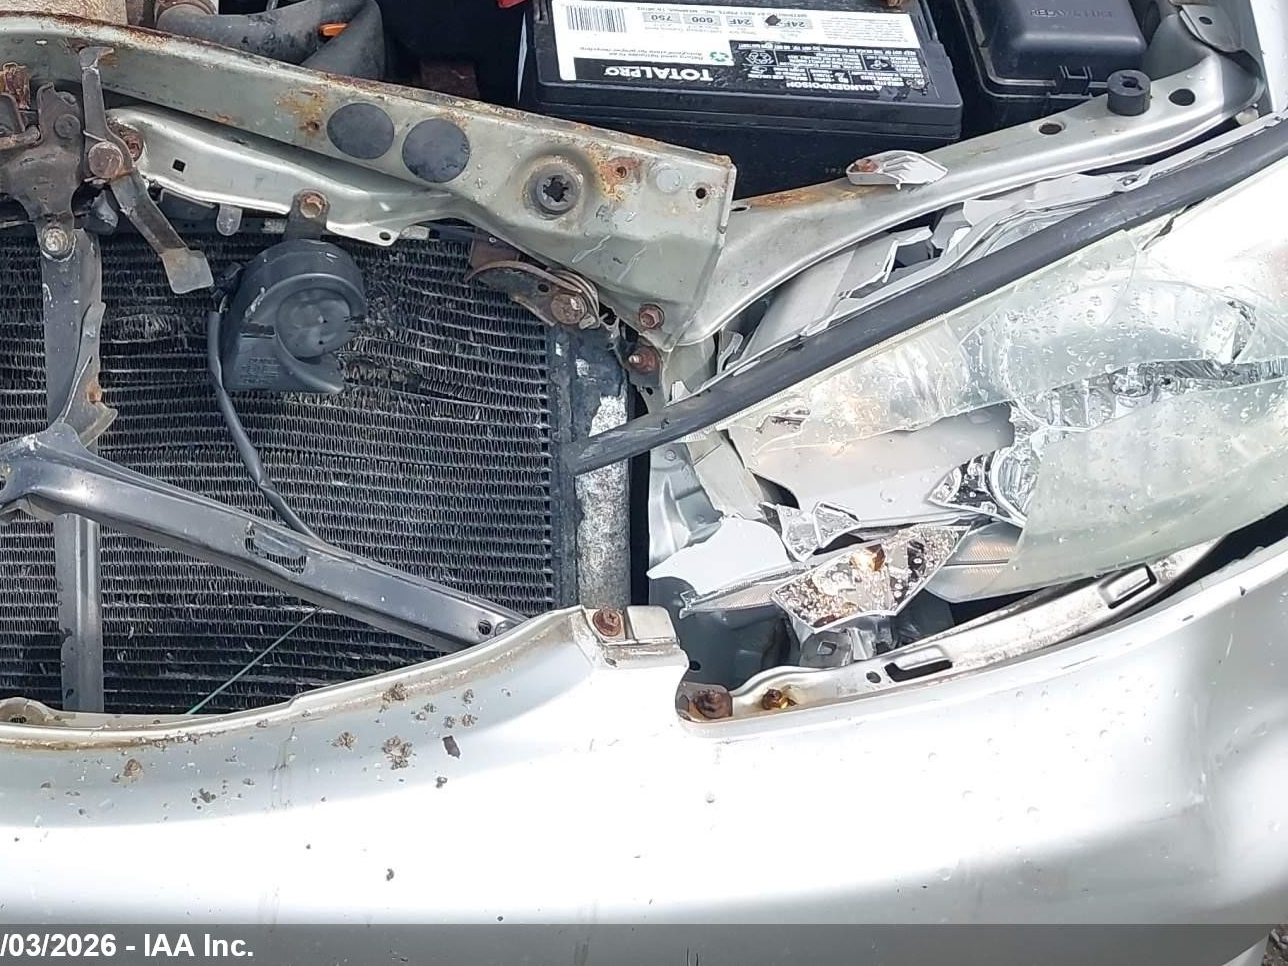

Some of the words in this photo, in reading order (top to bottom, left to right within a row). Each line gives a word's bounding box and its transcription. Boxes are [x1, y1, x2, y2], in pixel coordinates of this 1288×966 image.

[650, 14, 673, 22] 750
[691, 16, 714, 24] 600
[604, 65, 714, 81] TOTALPRO
